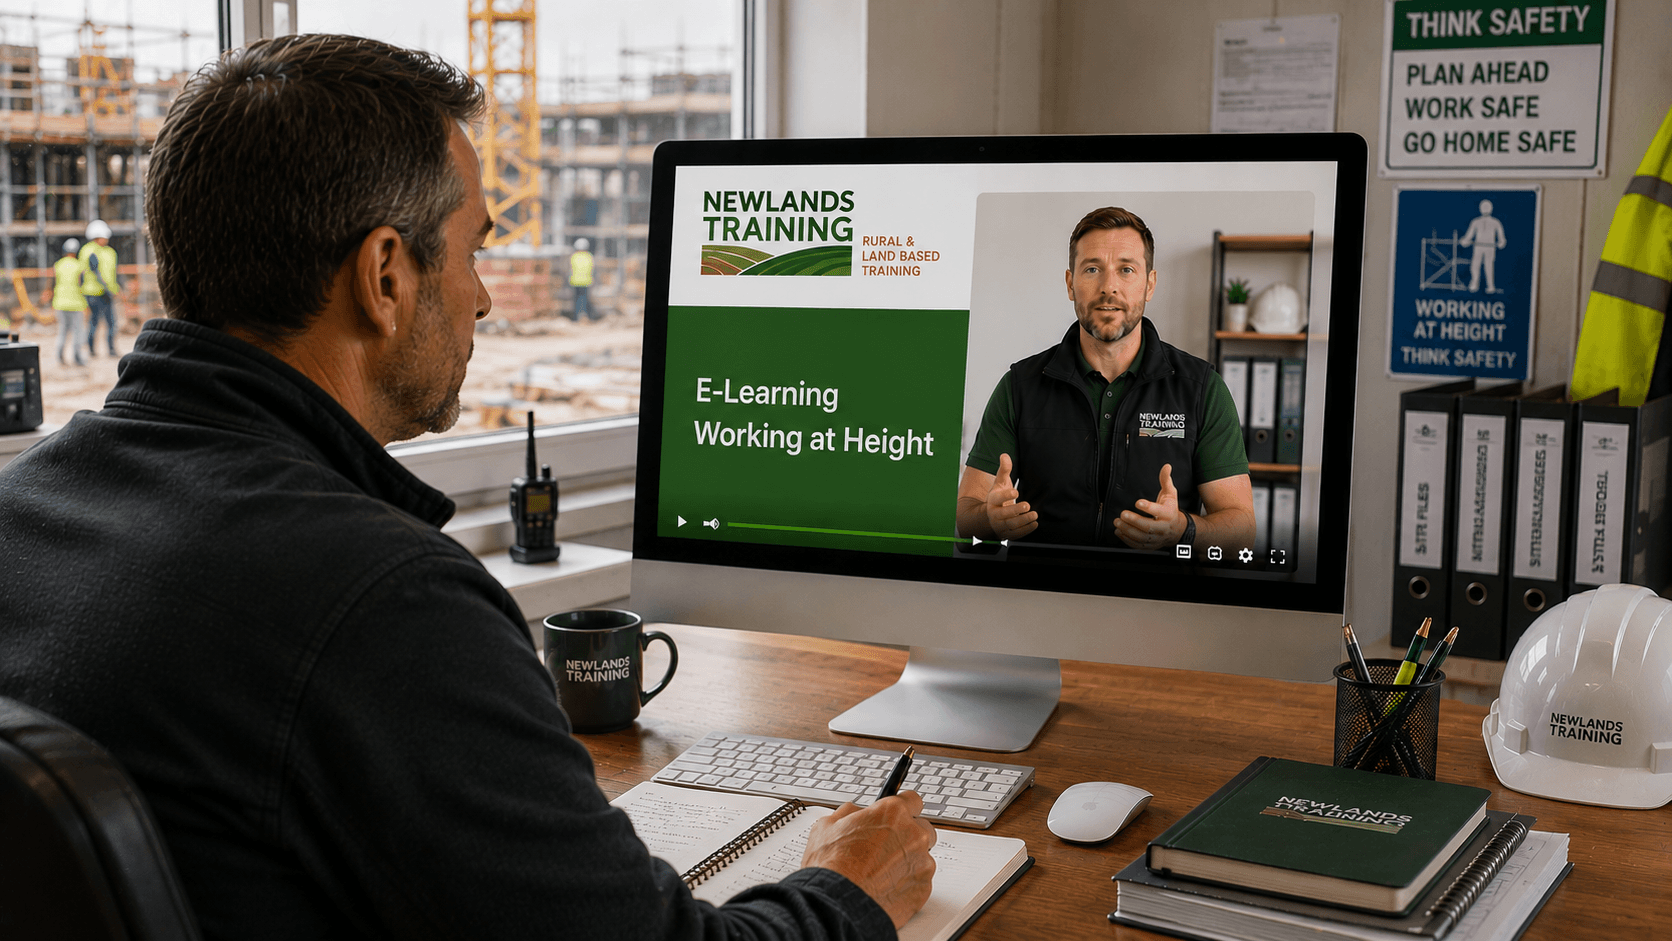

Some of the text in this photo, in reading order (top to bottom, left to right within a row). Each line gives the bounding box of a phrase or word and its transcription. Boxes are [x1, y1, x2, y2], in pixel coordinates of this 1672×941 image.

[1406, 5, 1590, 39] THINK SAFETY
[1406, 60, 1549, 86] PLAN AHEAD
[1405, 95, 1539, 119] WORK SAFE
[1403, 130, 1577, 153] GO HOME SAFE
[703, 190, 855, 213] NEWLANDS
[703, 216, 853, 242] TRAINING
[862, 235, 915, 247] RURAL &
[862, 250, 941, 262] LAND BASED
[862, 265, 921, 277] TRAINING
[1415, 299, 1505, 320] WORKING
[1413, 320, 1507, 342] AT HEIGHT
[1400, 346, 1517, 369] THINK SAFETY
[696, 377, 839, 413] E-Learning
[694, 420, 934, 461] Working at Height
[566, 656, 630, 671] NEWLANDS
[566, 667, 630, 682] TRAINING
[1550, 712, 1624, 733] NEWLANDS
[1550, 723, 1622, 746] TRAINING
[1278, 796, 1413, 823] NEWLANDS
